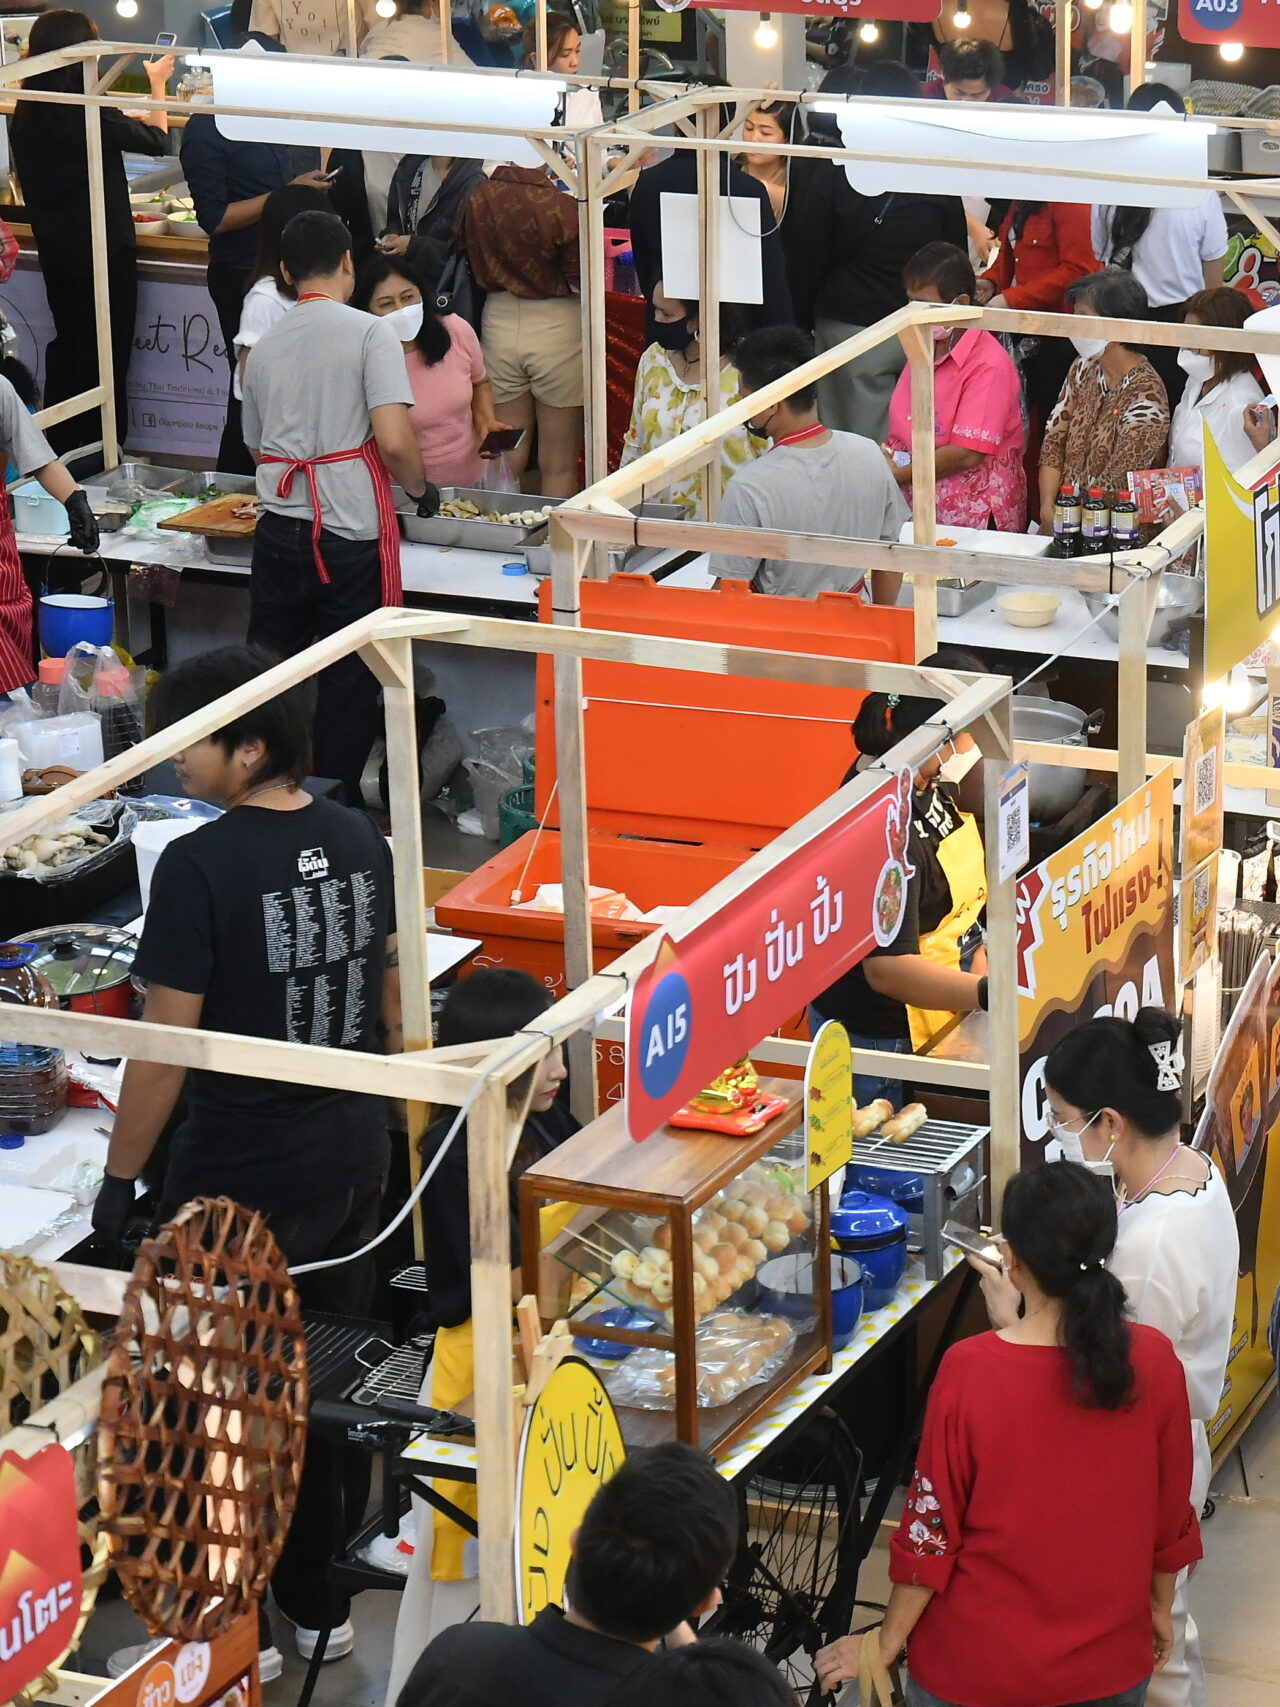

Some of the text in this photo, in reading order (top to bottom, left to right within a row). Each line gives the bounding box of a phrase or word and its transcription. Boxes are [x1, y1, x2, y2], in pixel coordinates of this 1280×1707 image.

[131, 314, 176, 353] eet
[167, 383, 205, 395] Traditional
[1051, 791, 1152, 931] ธุรกิจใหม่
[765, 908, 804, 981] ปั่น
[810, 875, 843, 945] ปิ้ง
[645, 1003, 687, 1068] A15
[1022, 954, 1165, 1141] COA
